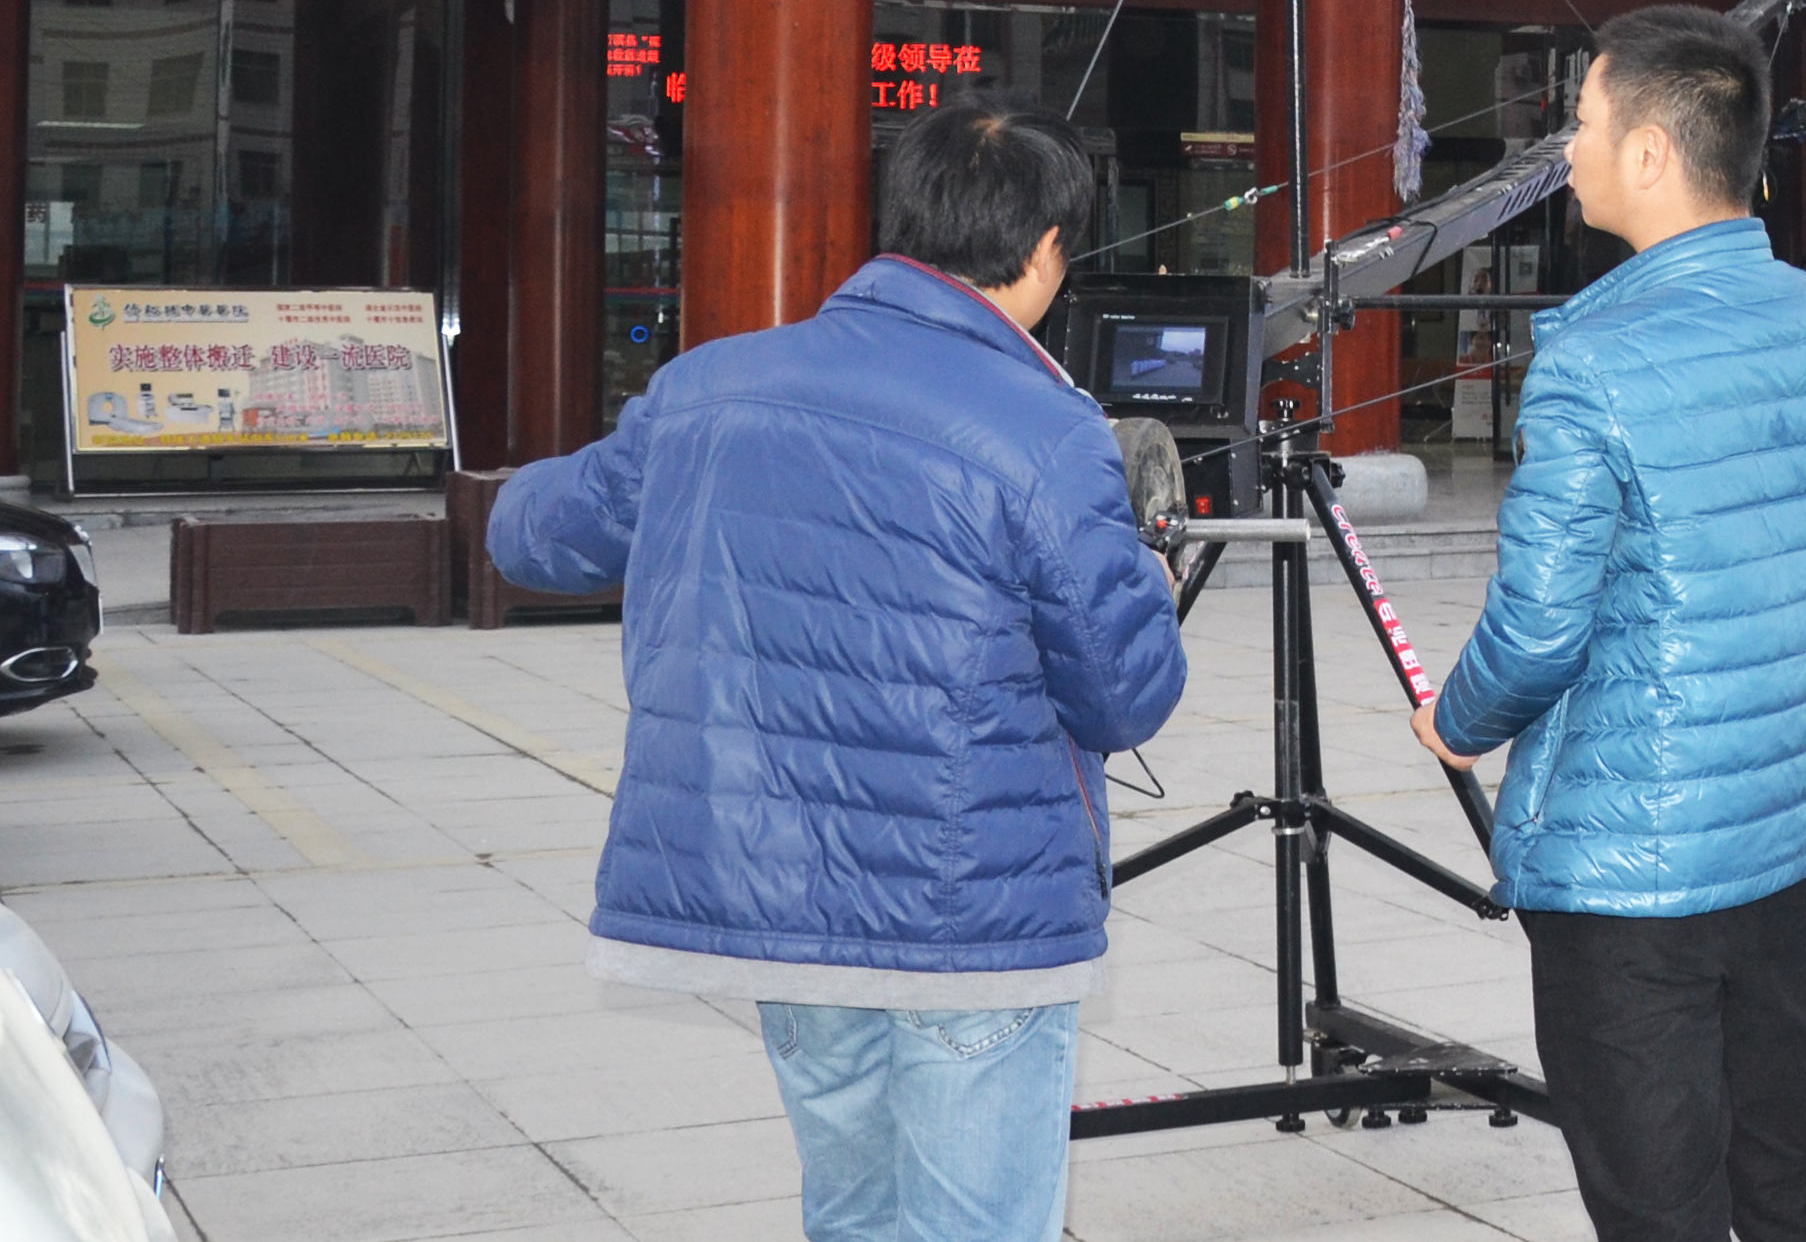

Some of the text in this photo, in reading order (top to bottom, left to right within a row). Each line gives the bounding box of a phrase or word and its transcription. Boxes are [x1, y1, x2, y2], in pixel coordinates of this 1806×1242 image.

[110, 343, 411, 371] 实施整体搬迁 建设一流医院
